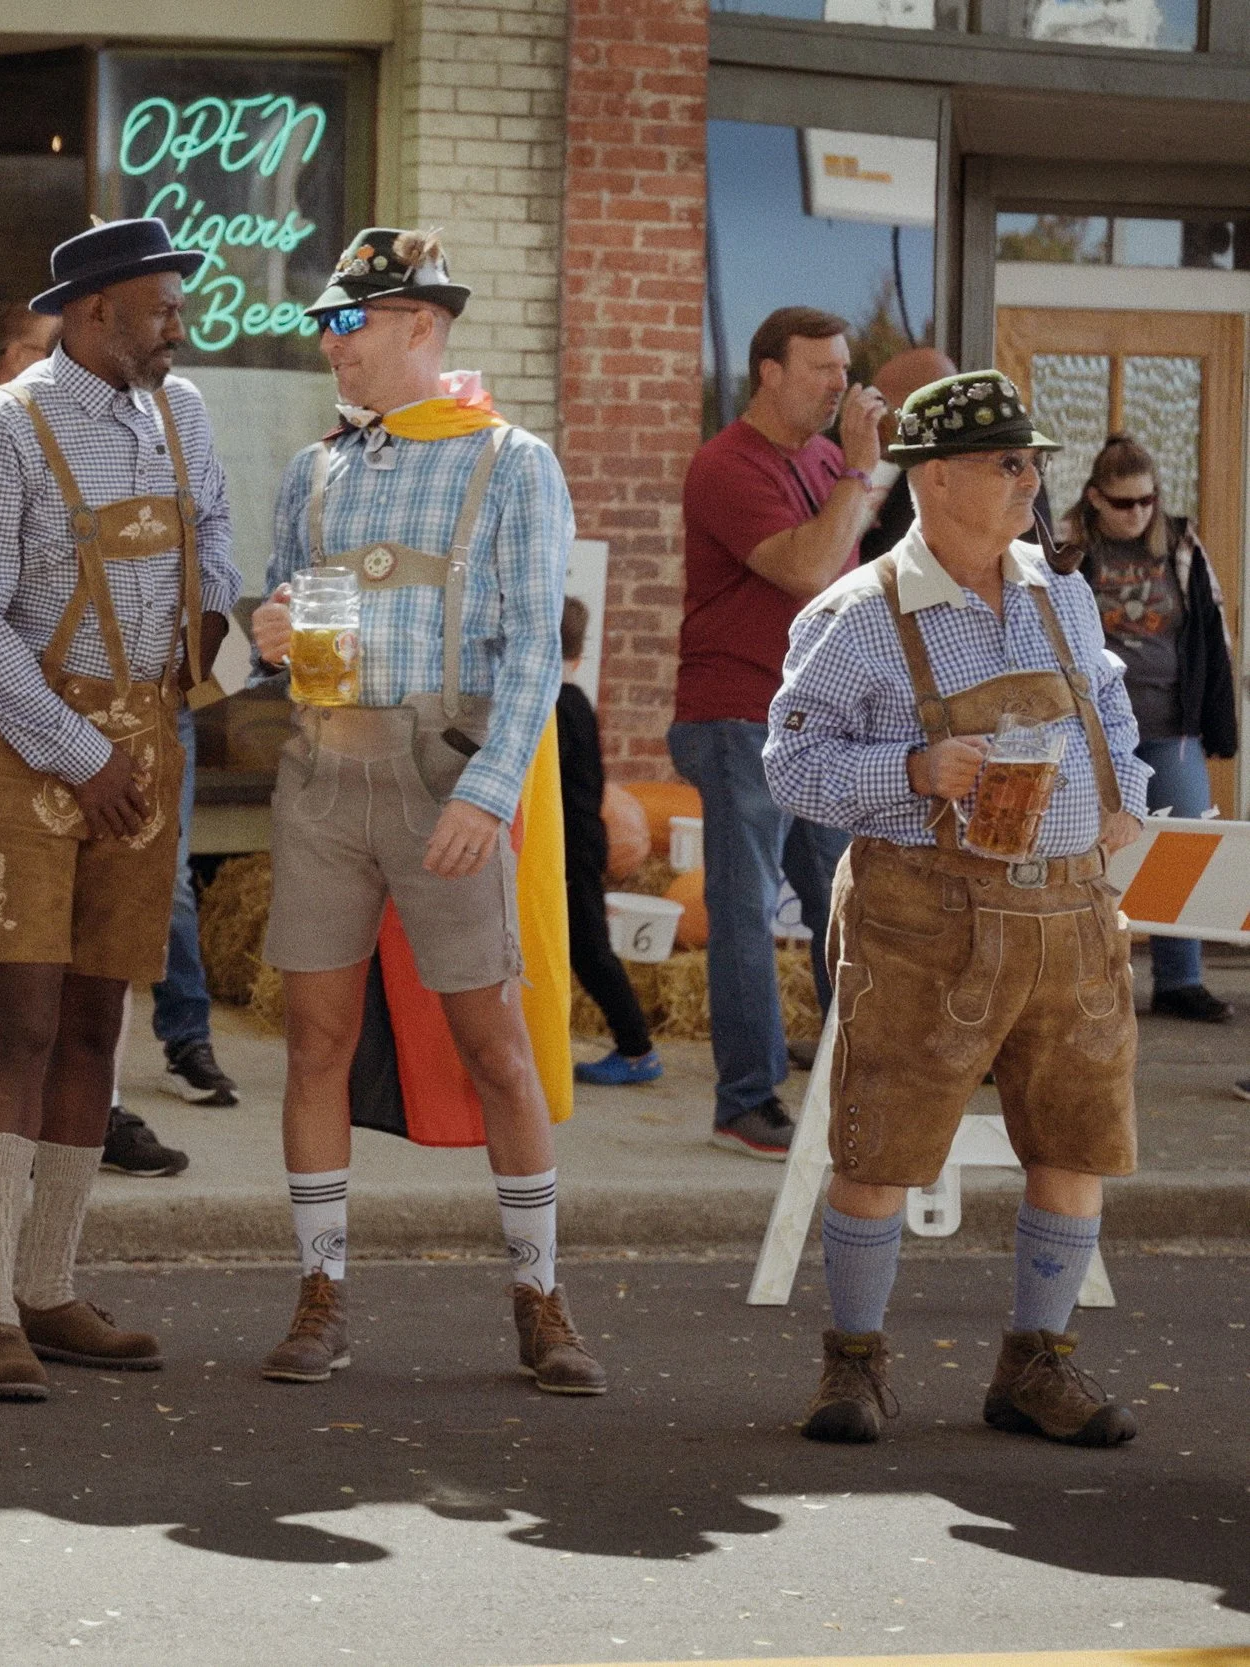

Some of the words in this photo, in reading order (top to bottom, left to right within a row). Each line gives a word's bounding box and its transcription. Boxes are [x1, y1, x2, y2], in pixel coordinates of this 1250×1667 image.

[120, 93, 327, 177] OPEN
[142, 182, 317, 294] Cigars
[189, 275, 320, 352] Beer
[632, 921, 653, 953] 6
